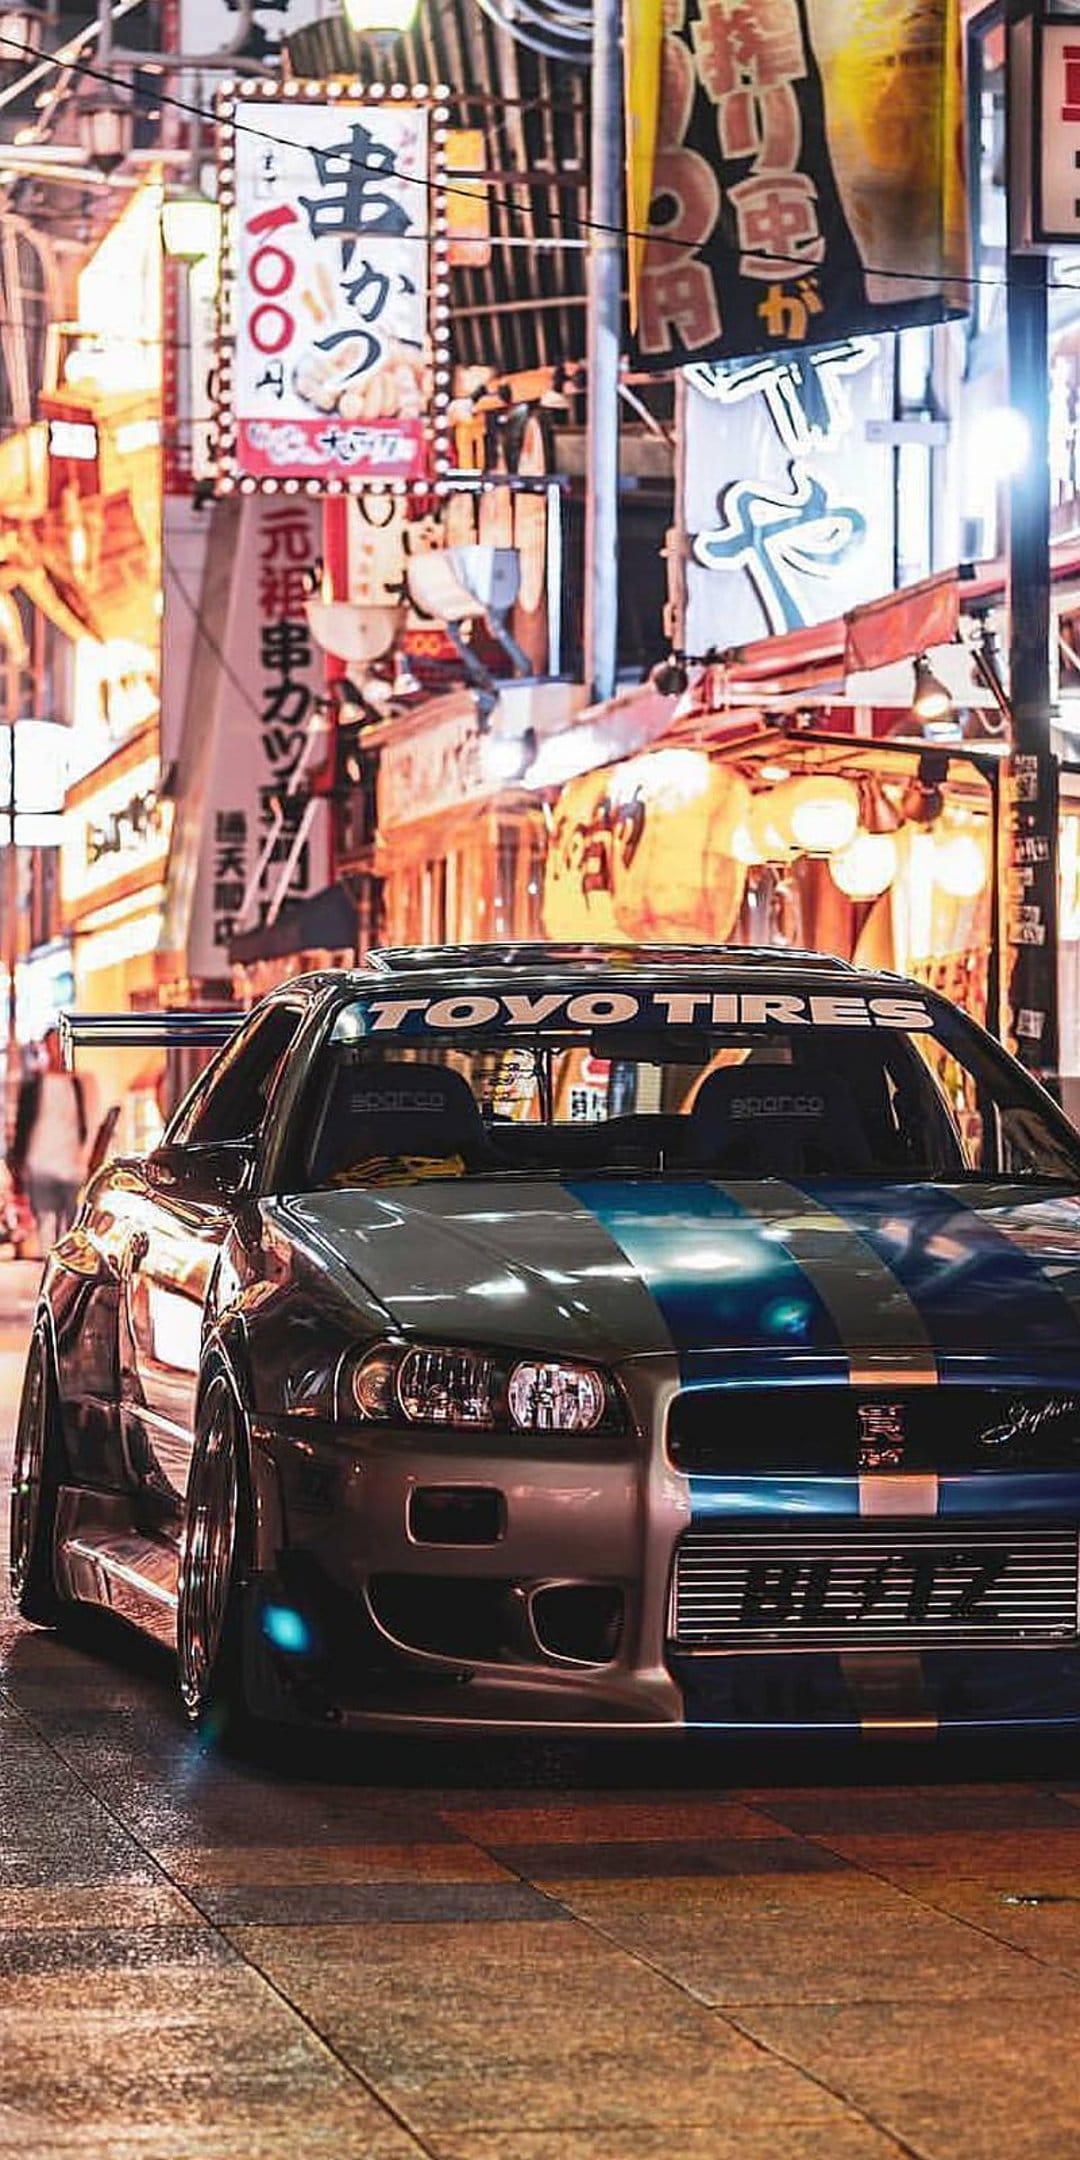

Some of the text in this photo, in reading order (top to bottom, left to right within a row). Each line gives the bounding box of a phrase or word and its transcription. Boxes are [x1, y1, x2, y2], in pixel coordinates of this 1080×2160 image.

[297, 122, 416, 384] 串かつ
[367, 991, 934, 1029] TOYO TIRES
[731, 1097, 825, 1119] sparco
